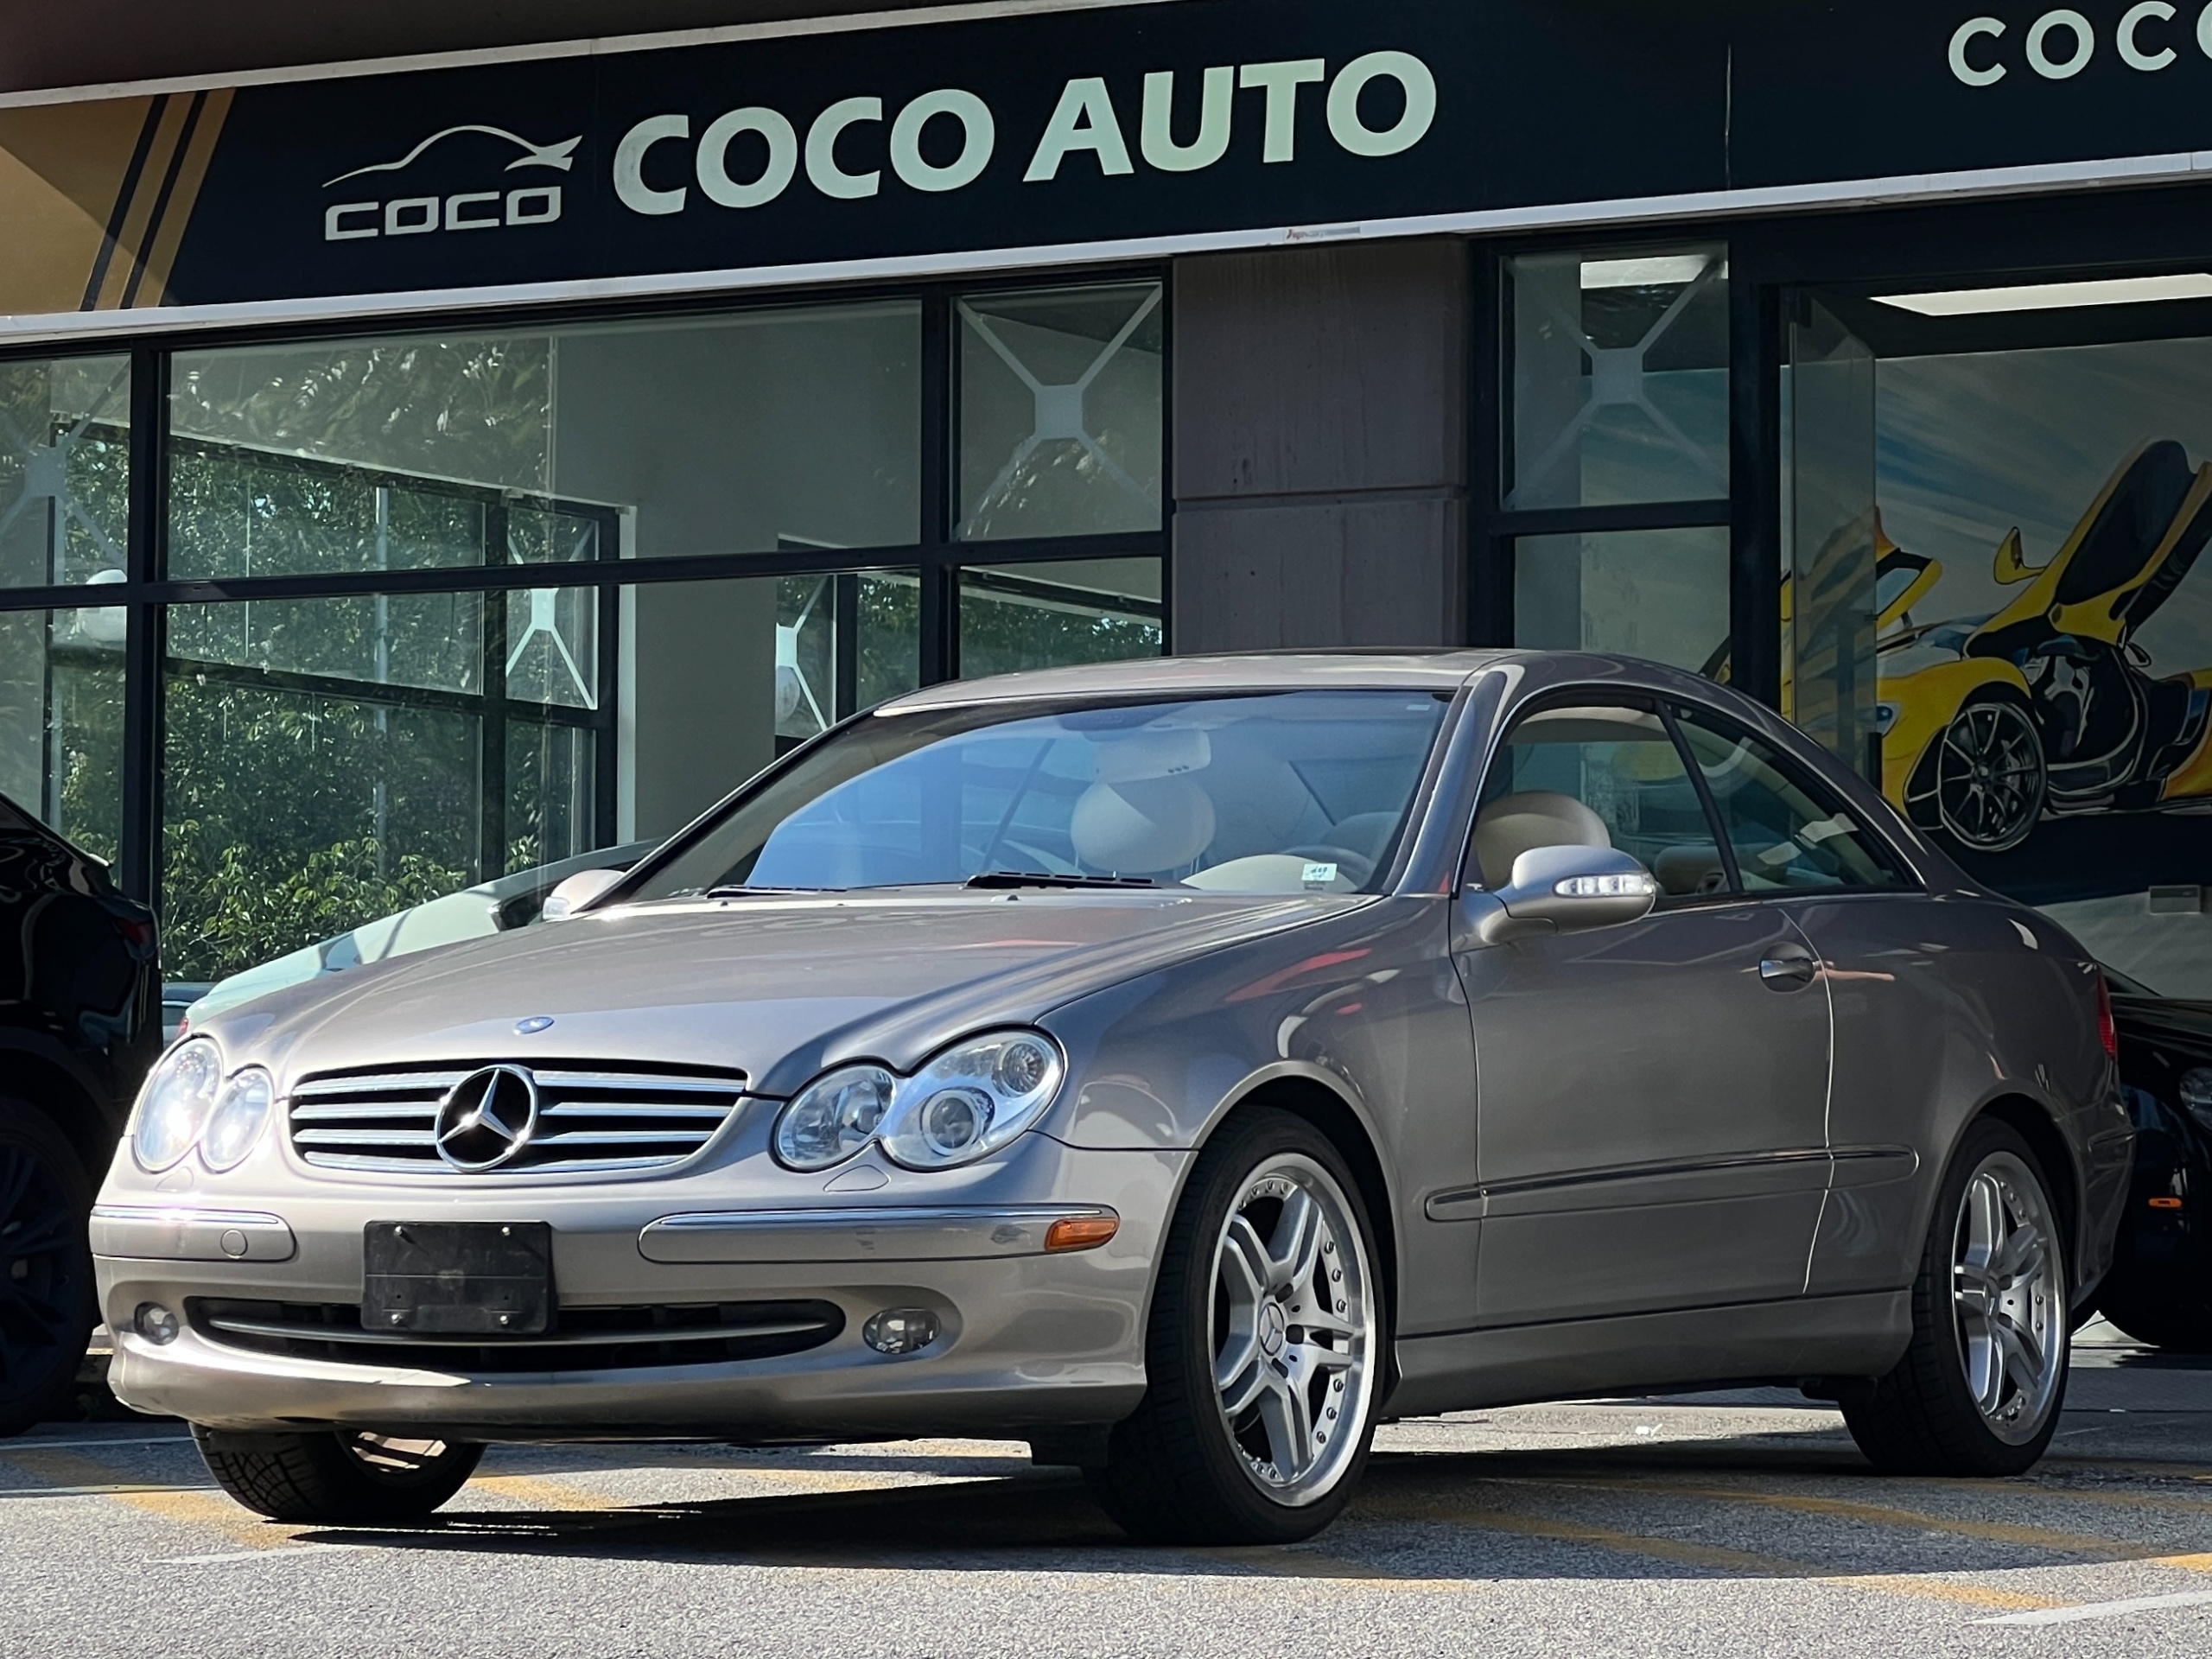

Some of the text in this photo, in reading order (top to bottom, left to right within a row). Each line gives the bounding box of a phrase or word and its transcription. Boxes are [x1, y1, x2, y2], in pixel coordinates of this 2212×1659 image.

[1948, 0, 2212, 86] COC
[613, 51, 1436, 215] COCO AUTO
[326, 187, 561, 240] COCO
